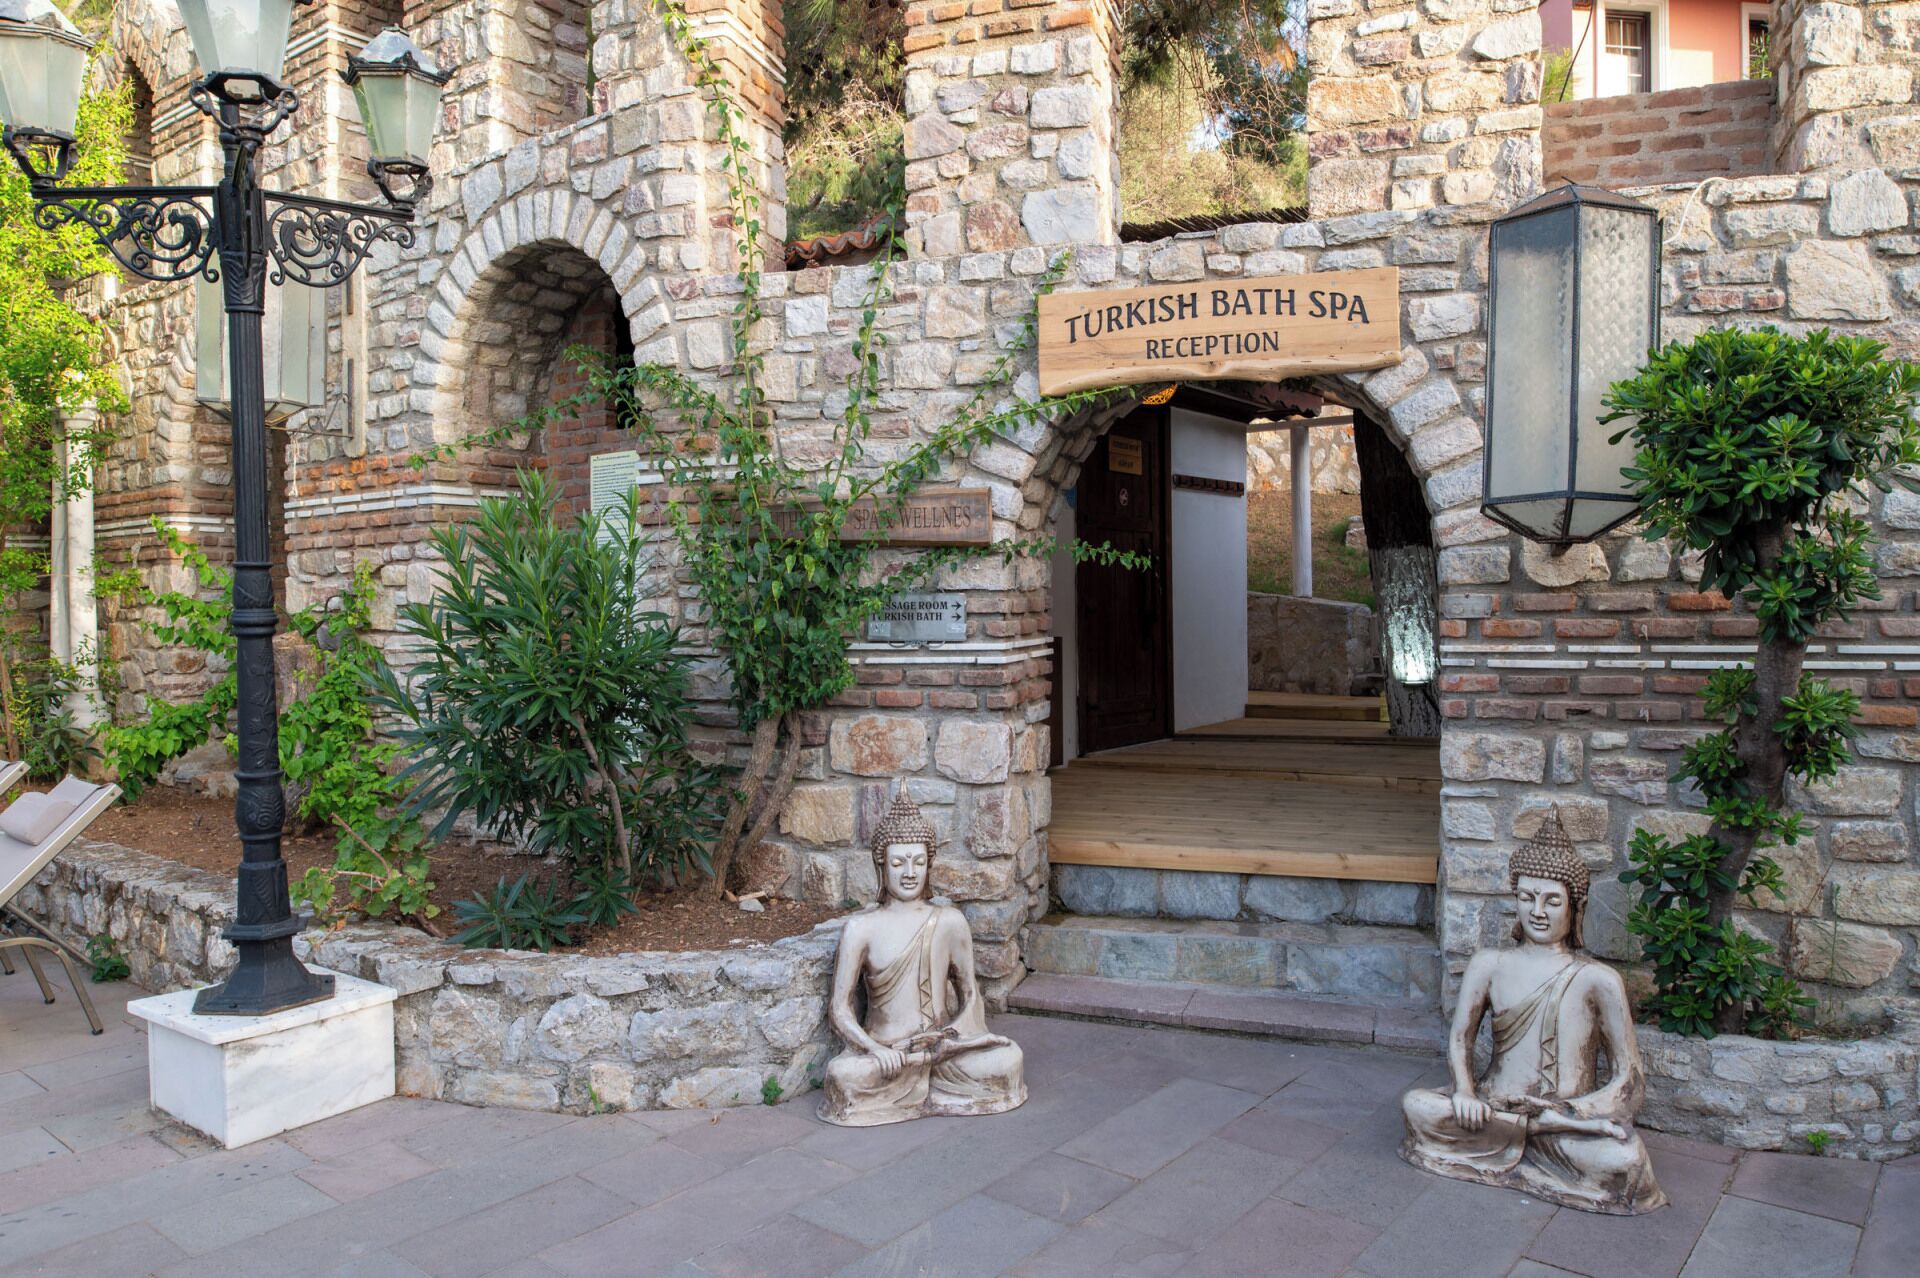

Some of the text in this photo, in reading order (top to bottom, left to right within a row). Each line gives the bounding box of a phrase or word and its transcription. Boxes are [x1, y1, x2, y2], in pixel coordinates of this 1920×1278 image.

[1064, 288, 1370, 344] TURKISH BATH SPA
[1145, 331, 1280, 360] RECEPTION
[853, 508, 880, 530] SPA
[898, 505, 972, 529] WELLNES
[881, 601, 948, 610] SSAGE ROOM
[916, 611, 942, 621] BATH
